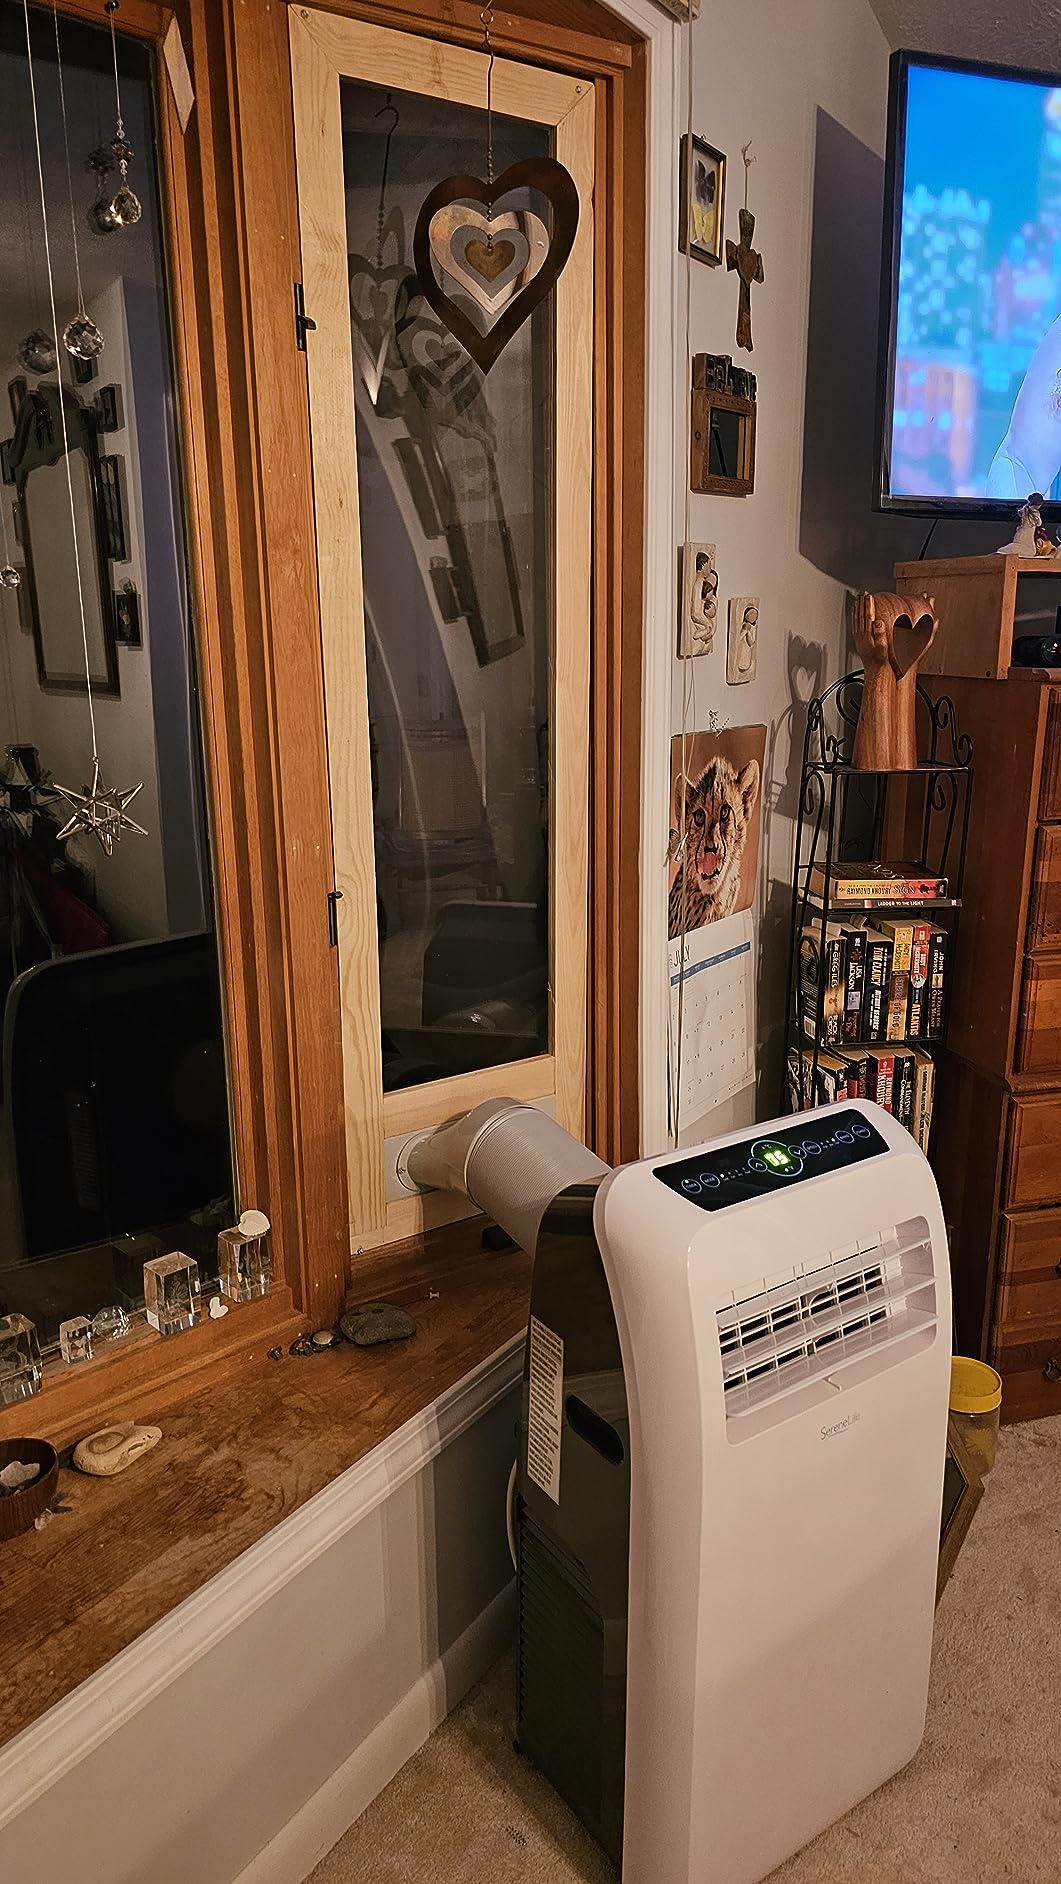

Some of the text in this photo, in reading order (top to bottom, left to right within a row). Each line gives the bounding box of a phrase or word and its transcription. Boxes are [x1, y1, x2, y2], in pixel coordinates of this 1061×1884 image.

[847, 887, 891, 895] RAYMOND KHOURY
[873, 947, 883, 962] TOM
[831, 951, 840, 987] GREG ILES
[848, 961, 858, 990] JACKSON
[871, 962, 882, 986] CLANCY
[894, 1002, 902, 1010] OF
[892, 1011, 901, 1028] GOLD
[910, 1003, 920, 1036] ATLANTIS
[877, 1075, 887, 1109] KHOURY
[885, 1077, 893, 1105] RAYMOND
